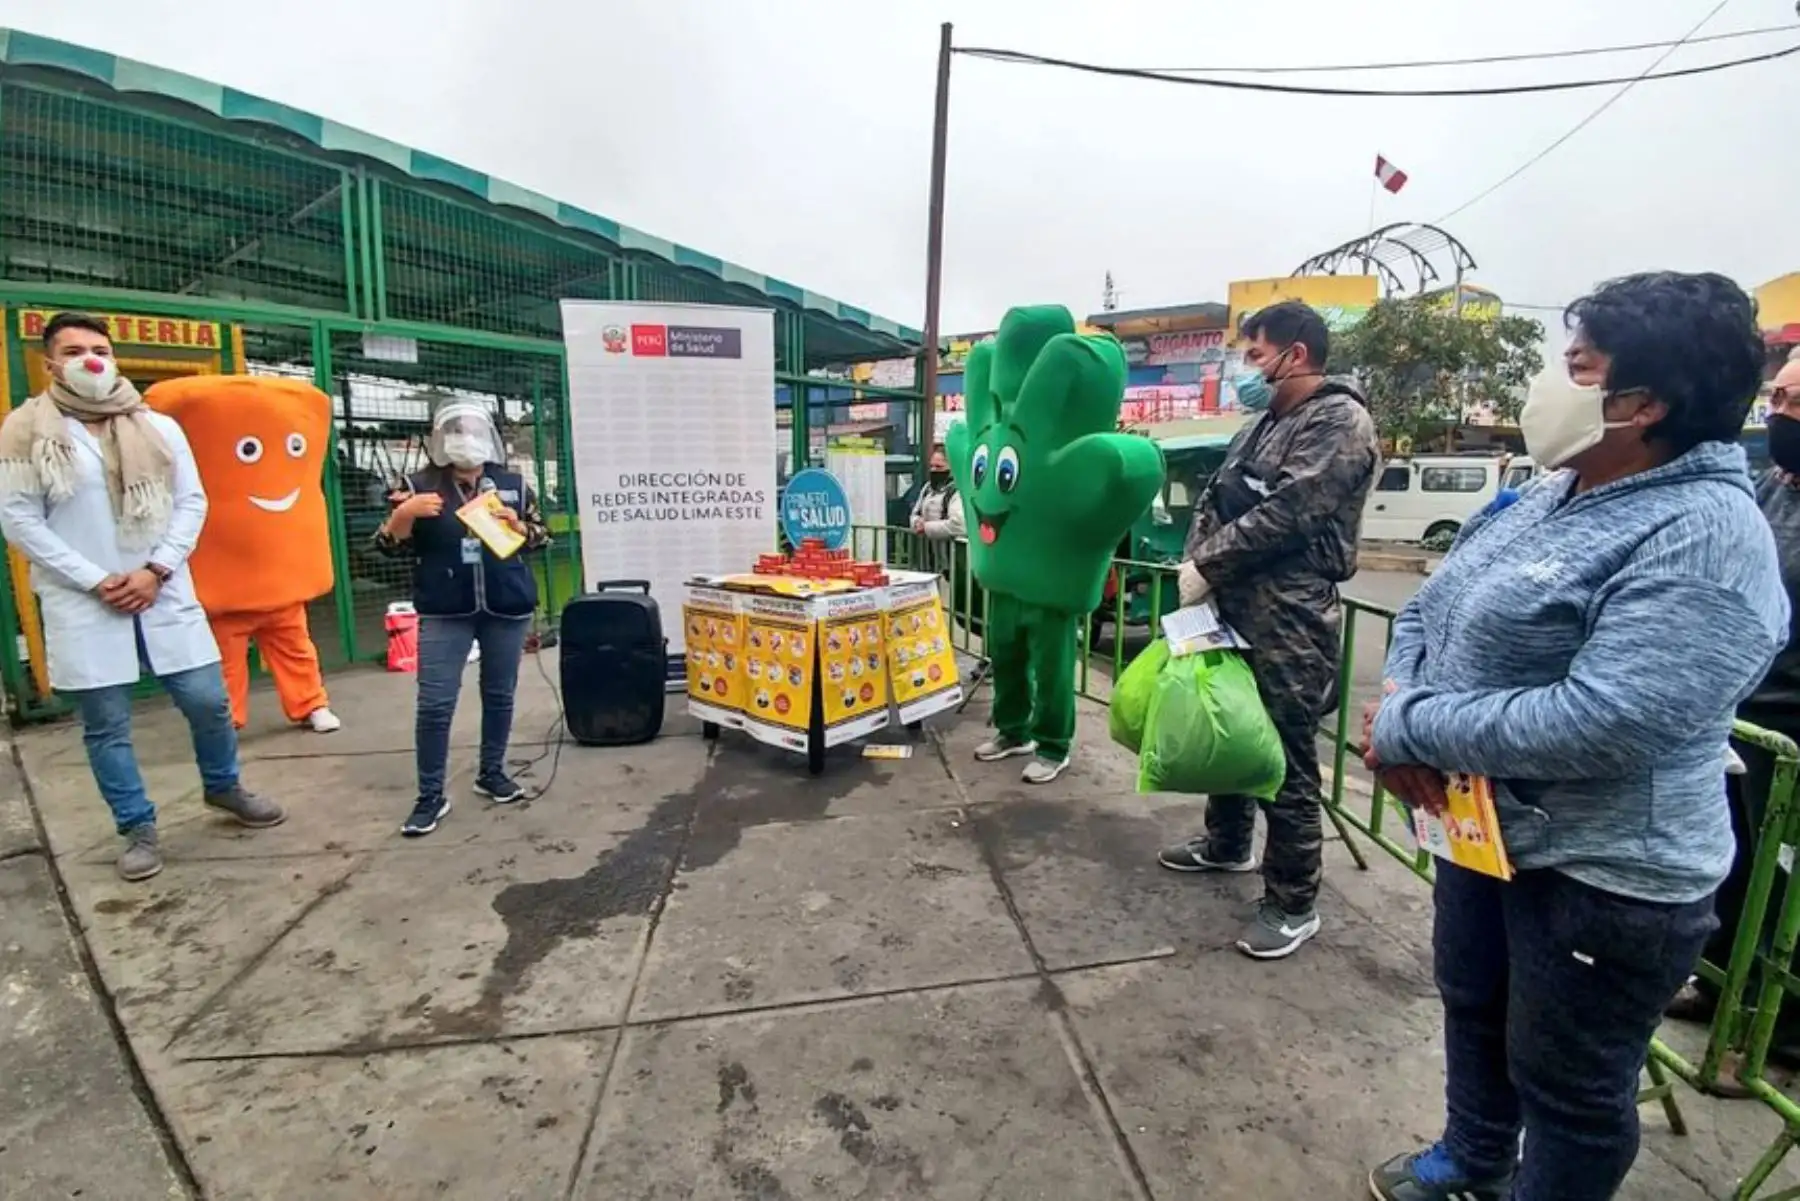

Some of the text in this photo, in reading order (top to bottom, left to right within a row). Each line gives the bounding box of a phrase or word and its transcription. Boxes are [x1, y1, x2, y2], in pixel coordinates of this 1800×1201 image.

[637, 333, 663, 346] PERÚ
[686, 342, 715, 353] Salud
[618, 469, 746, 488] DIRECCIÓN DE
[592, 490, 765, 508] REDES INTEGRADAS
[598, 506, 763, 524] DE SALUD LIMA ESTE
[800, 506, 846, 529] SALUD
